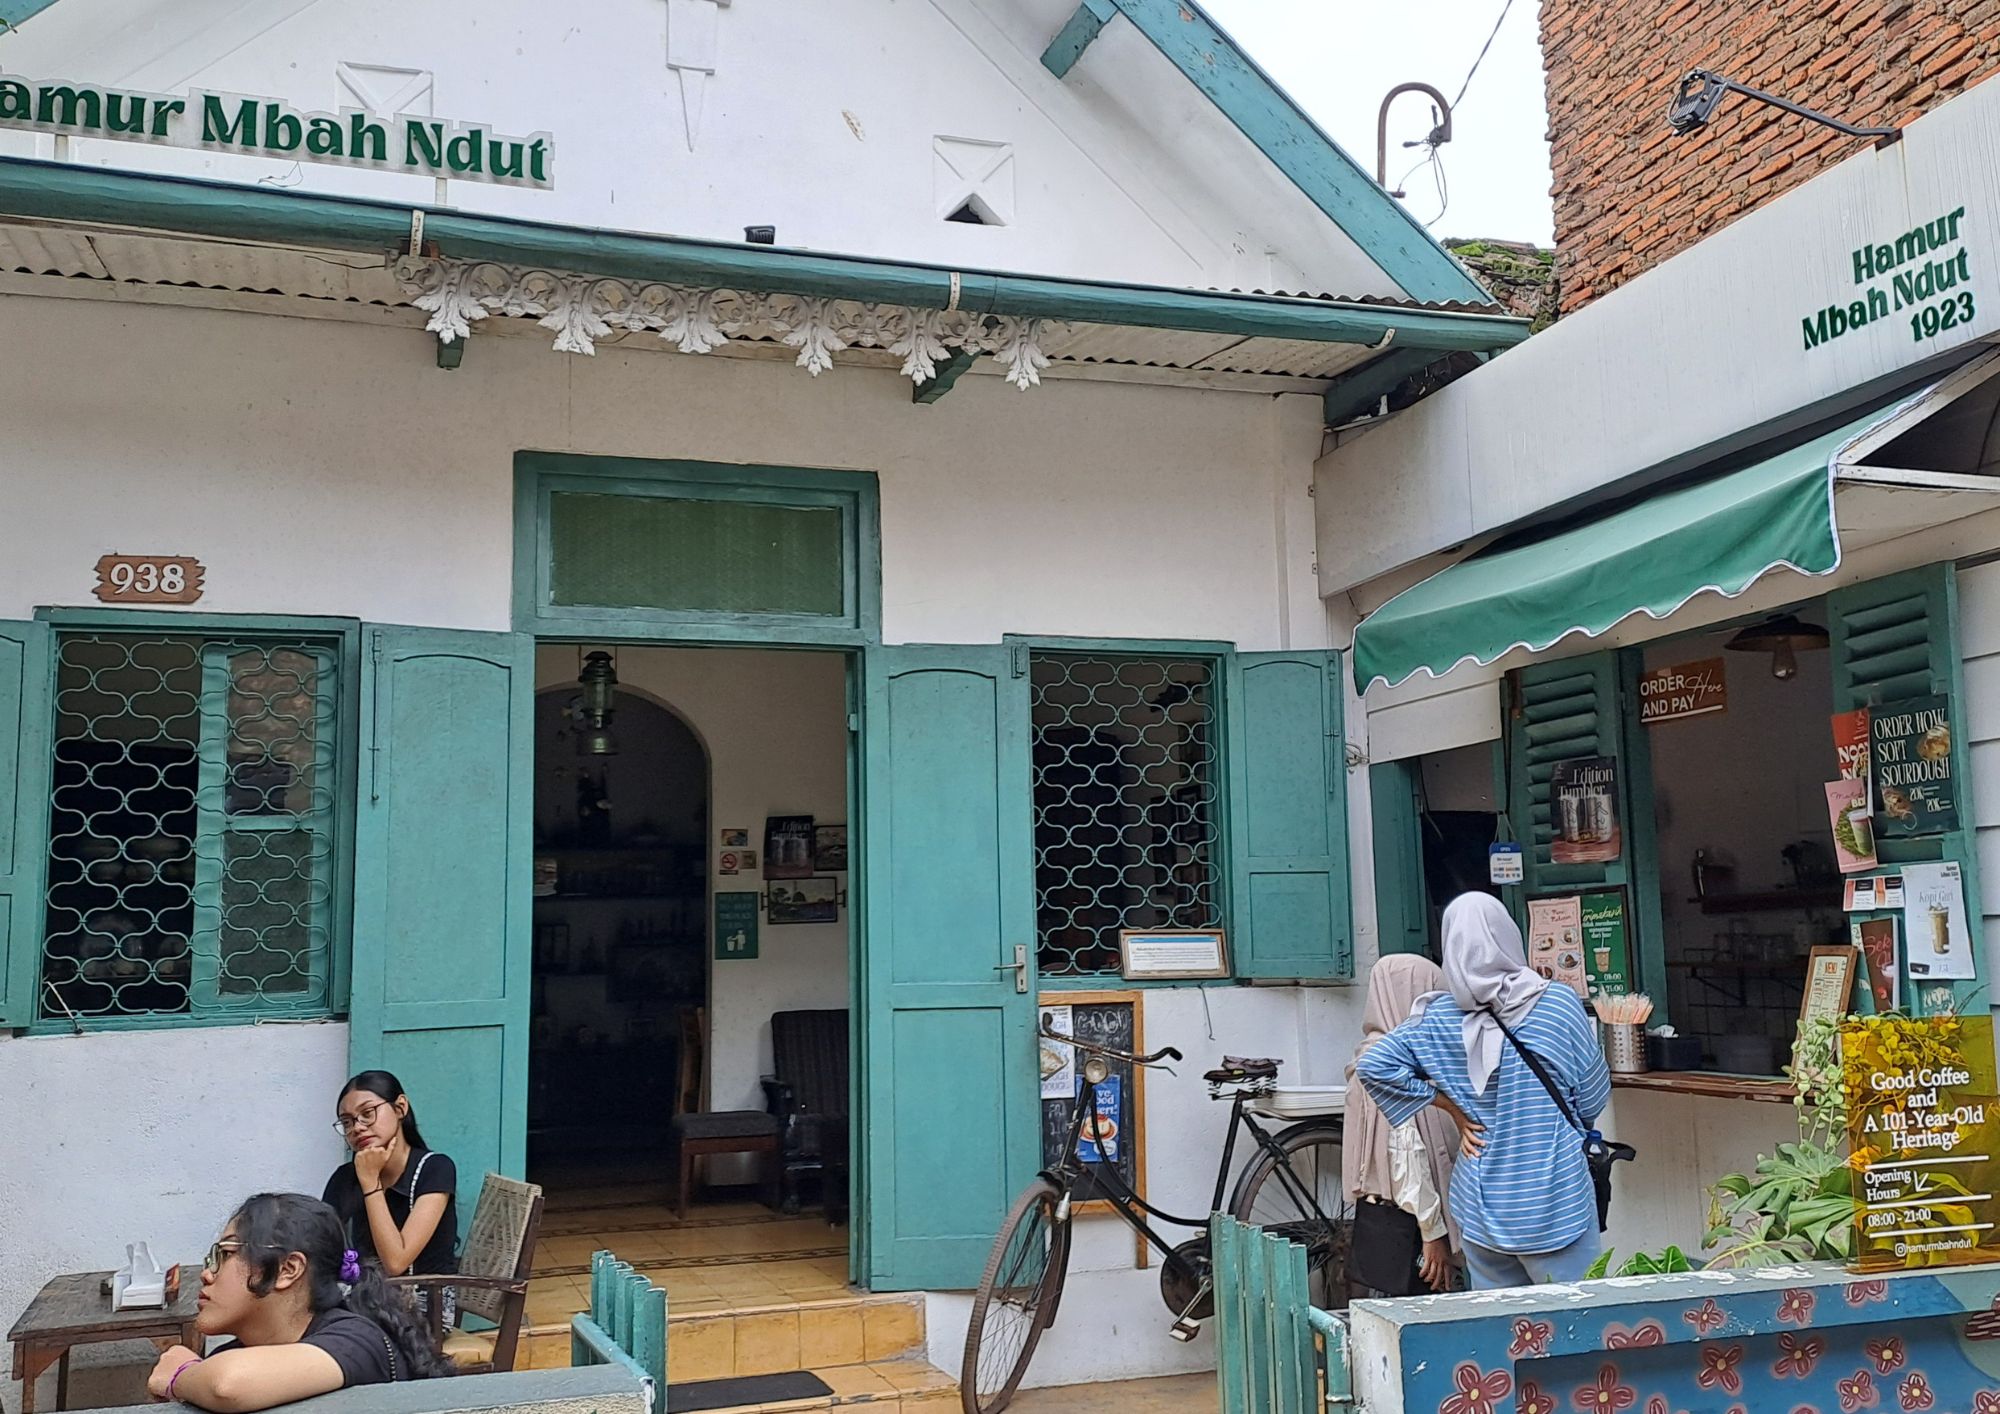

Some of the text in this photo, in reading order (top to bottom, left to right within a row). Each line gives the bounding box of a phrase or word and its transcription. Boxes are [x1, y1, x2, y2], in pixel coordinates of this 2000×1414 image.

[0, 81, 548, 181] amur Mbah Ndut
[1852, 206, 1965, 285] Hamur
[1802, 246, 1971, 350] Mbah Ndut
[1910, 291, 1975, 342] 1923
[110, 563, 185, 594] 938
[1640, 668, 1723, 702] ORDER Here
[1642, 694, 1695, 717] AND PAY
[1874, 714, 1913, 740] ORDER
[1572, 766, 1613, 784] Edition
[1881, 756, 1950, 787] SOURDOUGH
[1871, 1067, 1970, 1091] Good Coffee
[1907, 1088, 1938, 1108] and
[1864, 1105, 1984, 1133] A 101-Year-Old
[1891, 1130, 1961, 1151] Heritage
[1864, 1169, 1912, 1187] Opening
[1866, 1188, 1900, 1202] Hours
[1867, 1212, 1895, 1227] 08:00
[1904, 1208, 1931, 1224] 21:00
